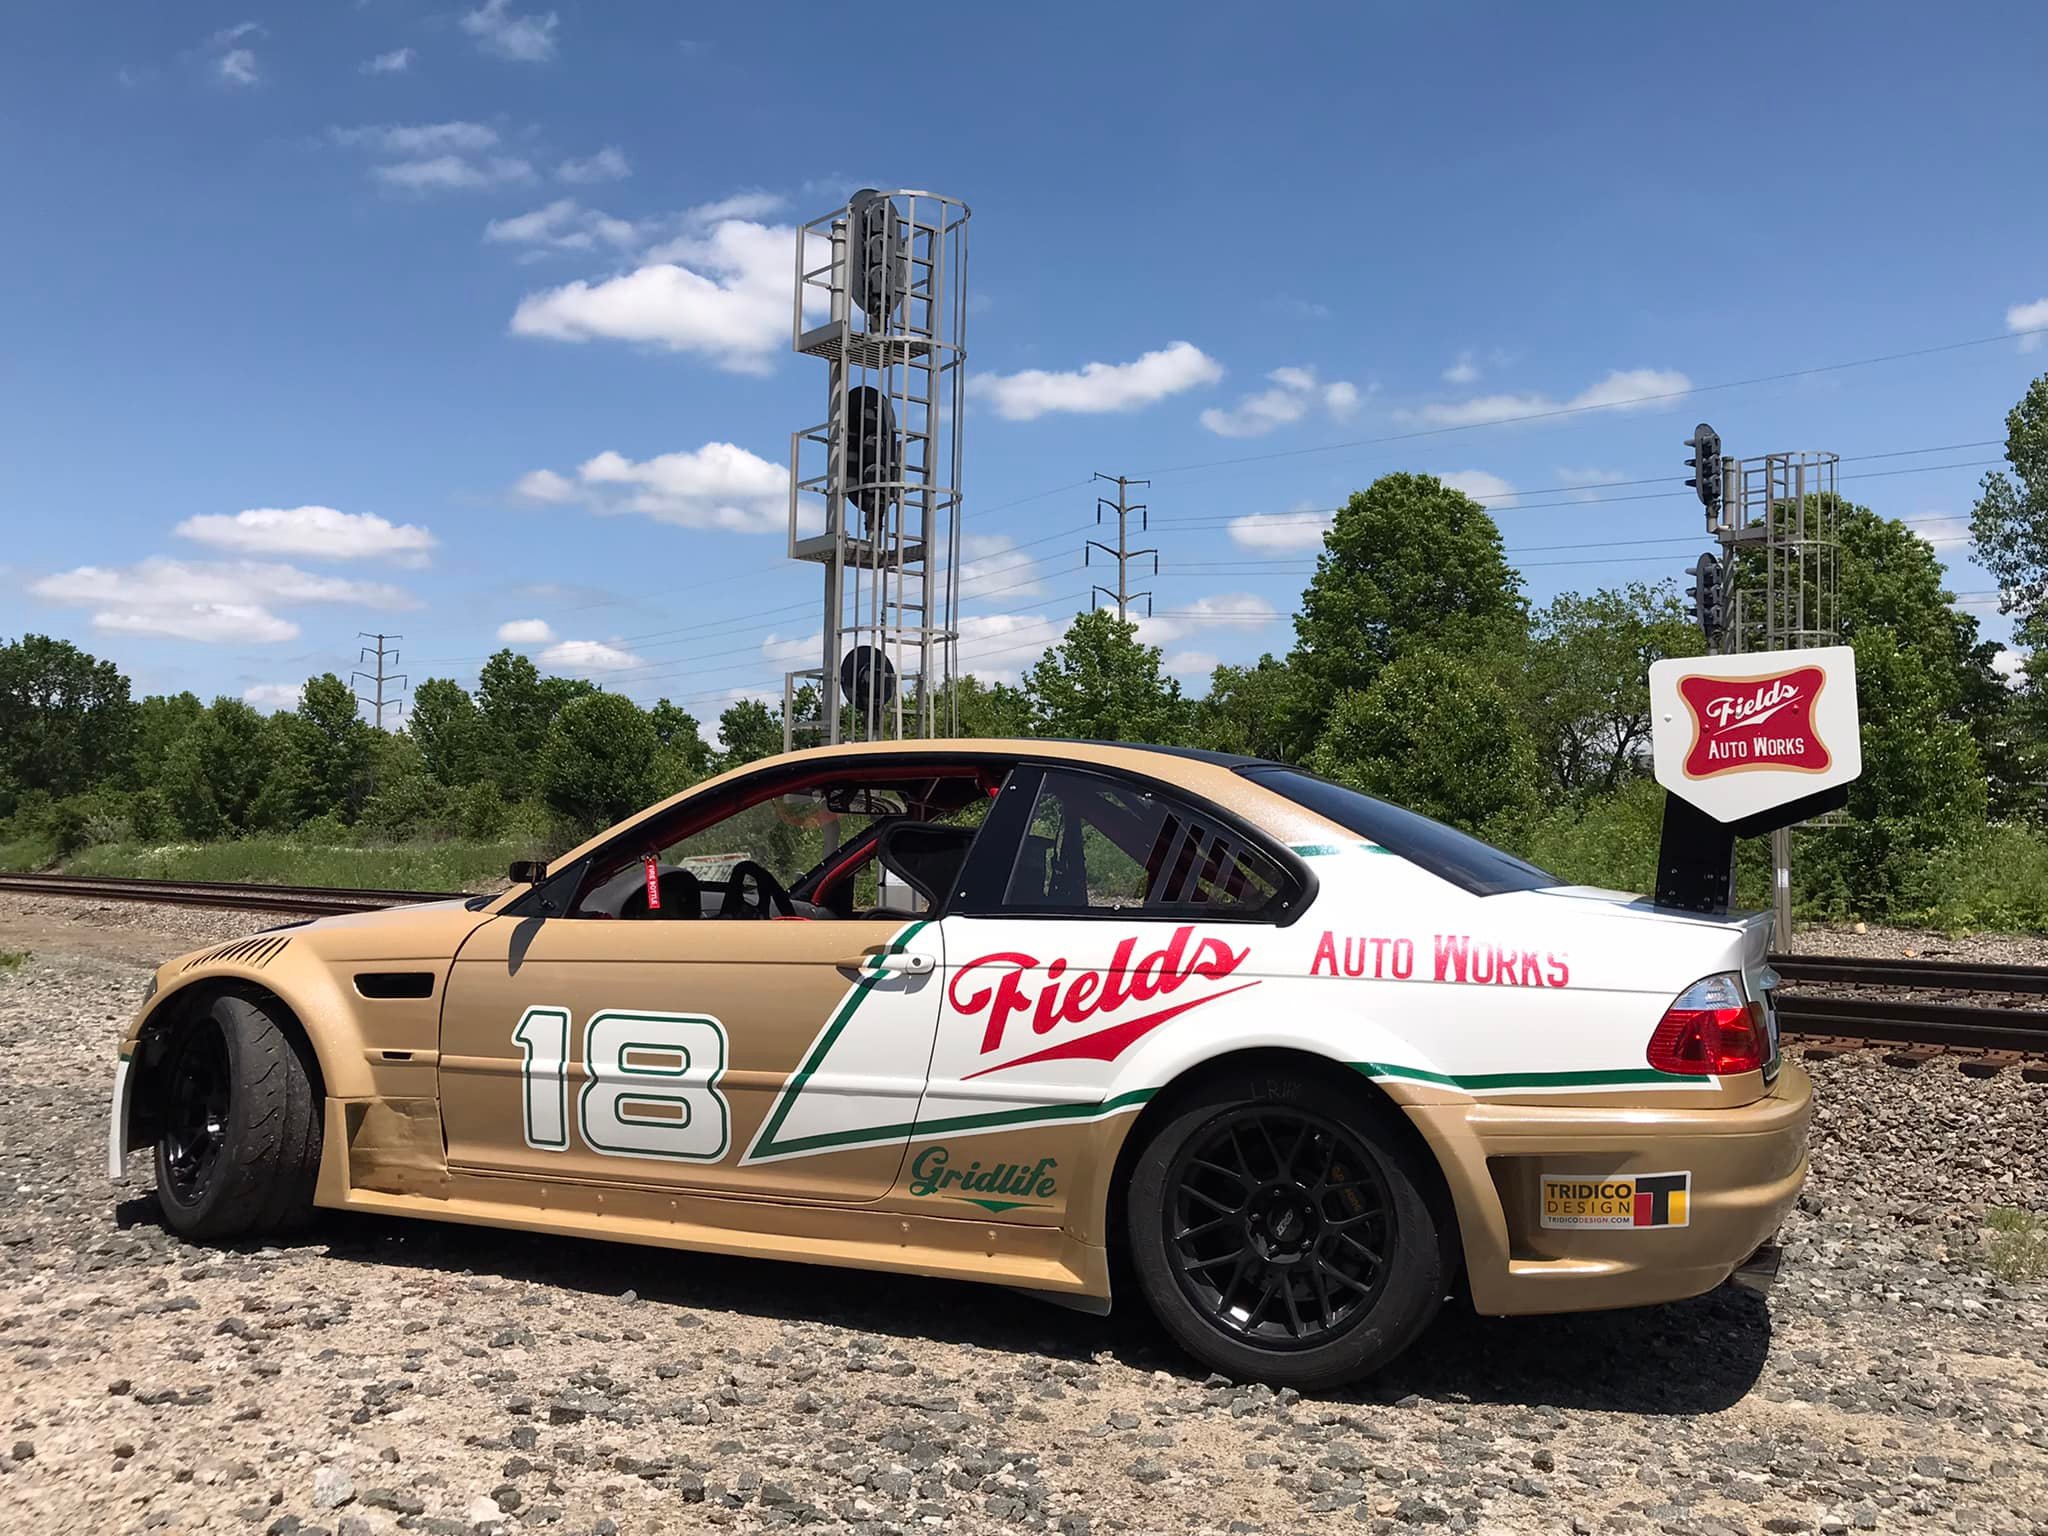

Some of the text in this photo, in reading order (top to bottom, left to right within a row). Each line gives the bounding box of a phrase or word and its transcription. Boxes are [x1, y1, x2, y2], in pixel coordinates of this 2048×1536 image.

[1706, 680, 1799, 727] Fields
[1708, 737, 1804, 759] AUTO WORKS
[1310, 930, 1571, 987] AUTO WORKS
[948, 926, 1251, 1055] Fields
[511, 1005, 732, 1164] 18
[909, 1146, 1058, 1198] Gridlife
[1547, 1184, 1632, 1199] TRIDICO
[1547, 1201, 1630, 1214] DESIGN
[1548, 1216, 1630, 1224] TRIDICODESIGN.COM
